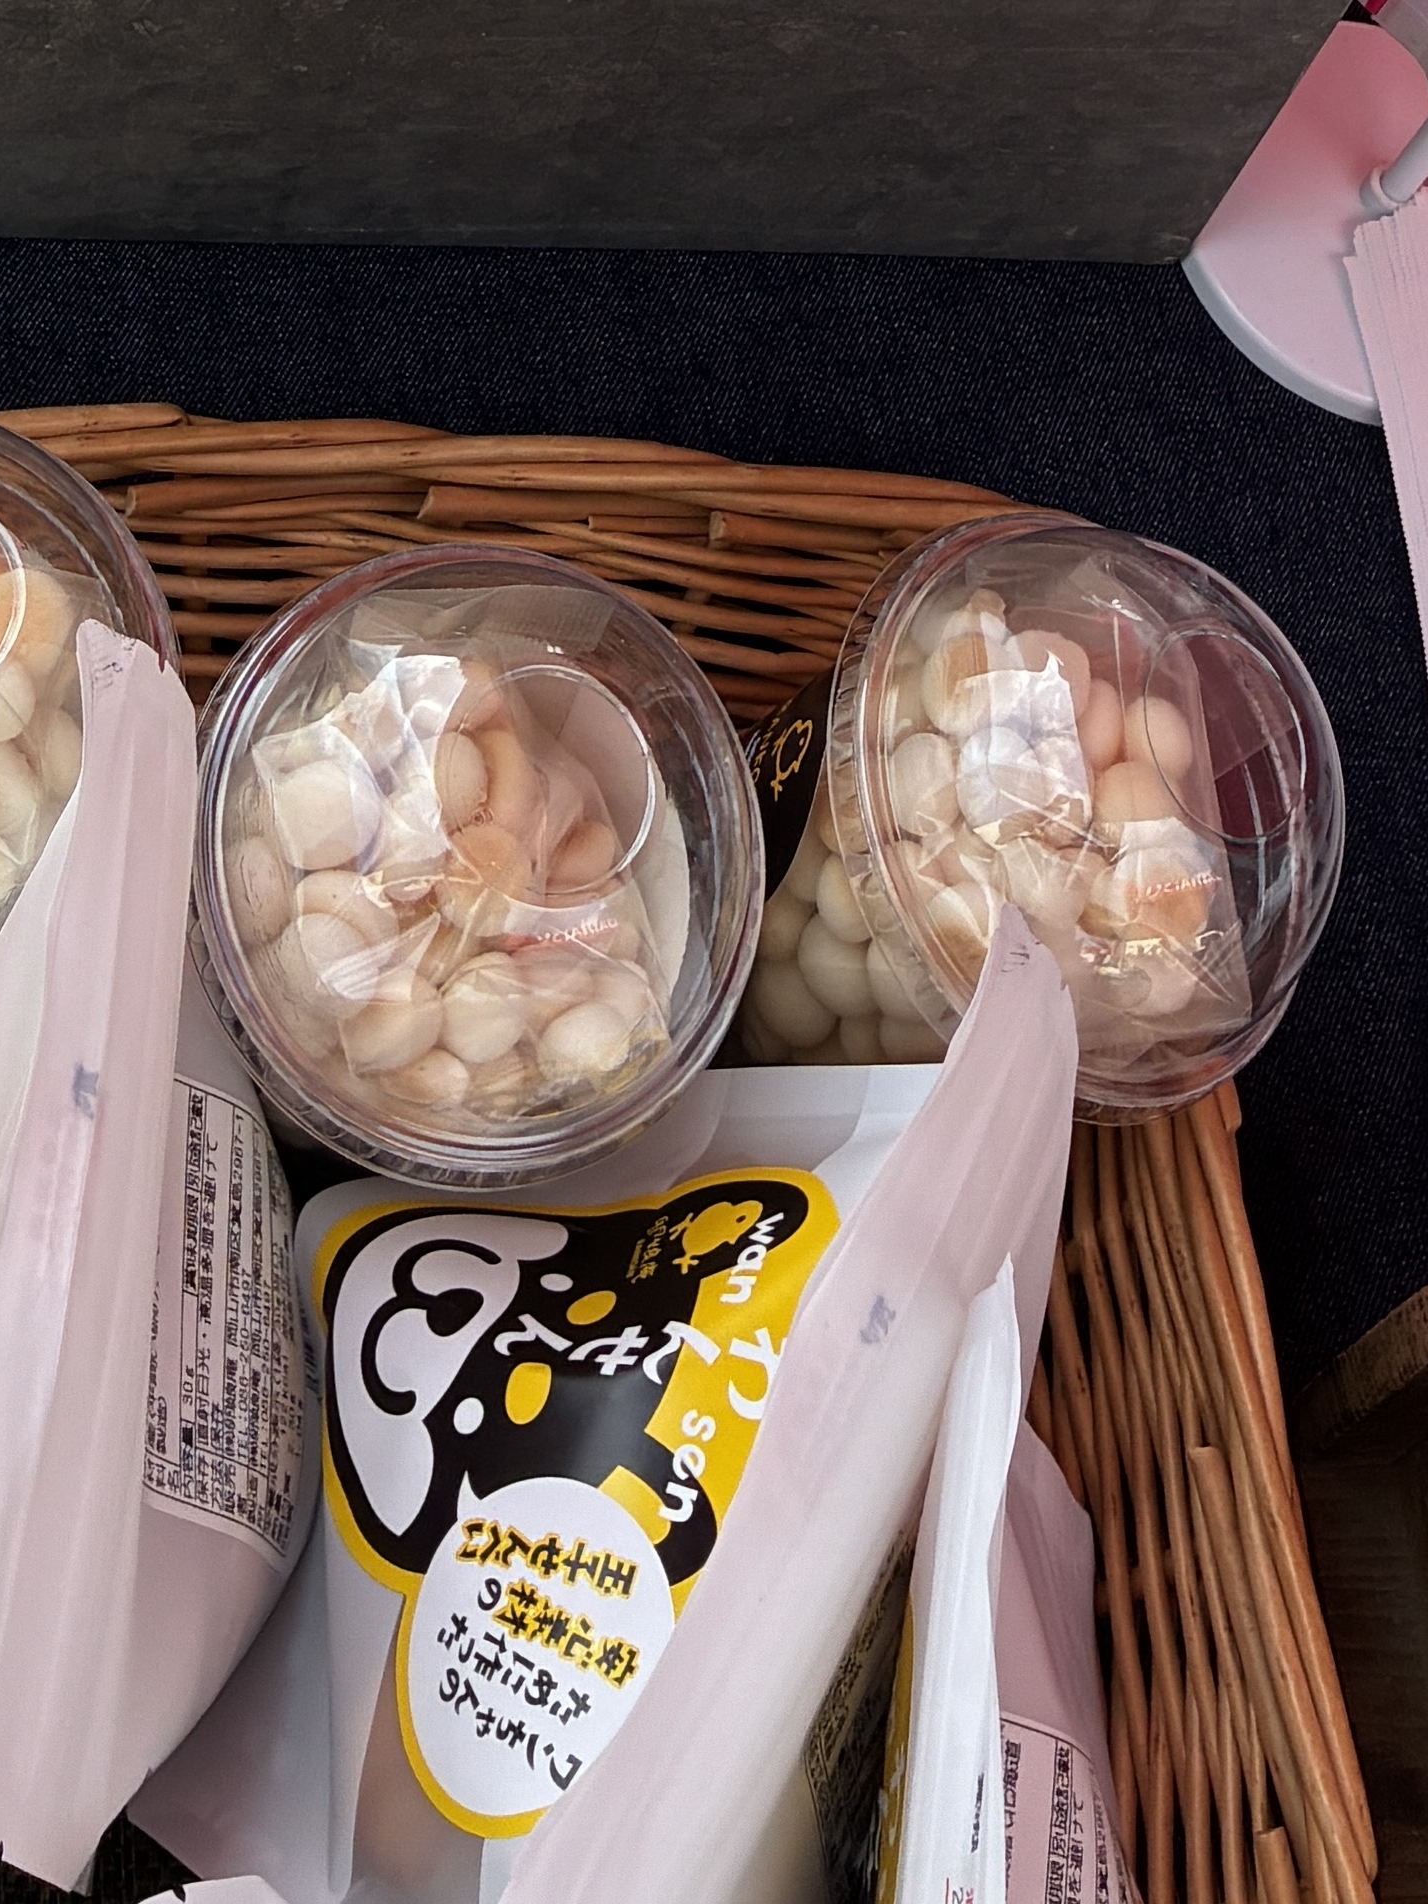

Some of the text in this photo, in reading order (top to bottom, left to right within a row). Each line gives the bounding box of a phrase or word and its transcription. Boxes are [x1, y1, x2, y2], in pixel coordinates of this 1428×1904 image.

[720, 1211, 783, 1302] wan
[493, 1313, 788, 1422] わんせん
[659, 1409, 718, 1520] sen
[460, 1520, 638, 1598] 玉子せんべい
[439, 1615, 591, 1723] ために作った
[479, 1579, 638, 1685] 安心素材の
[440, 1671, 582, 1787] ワンちゃんの
